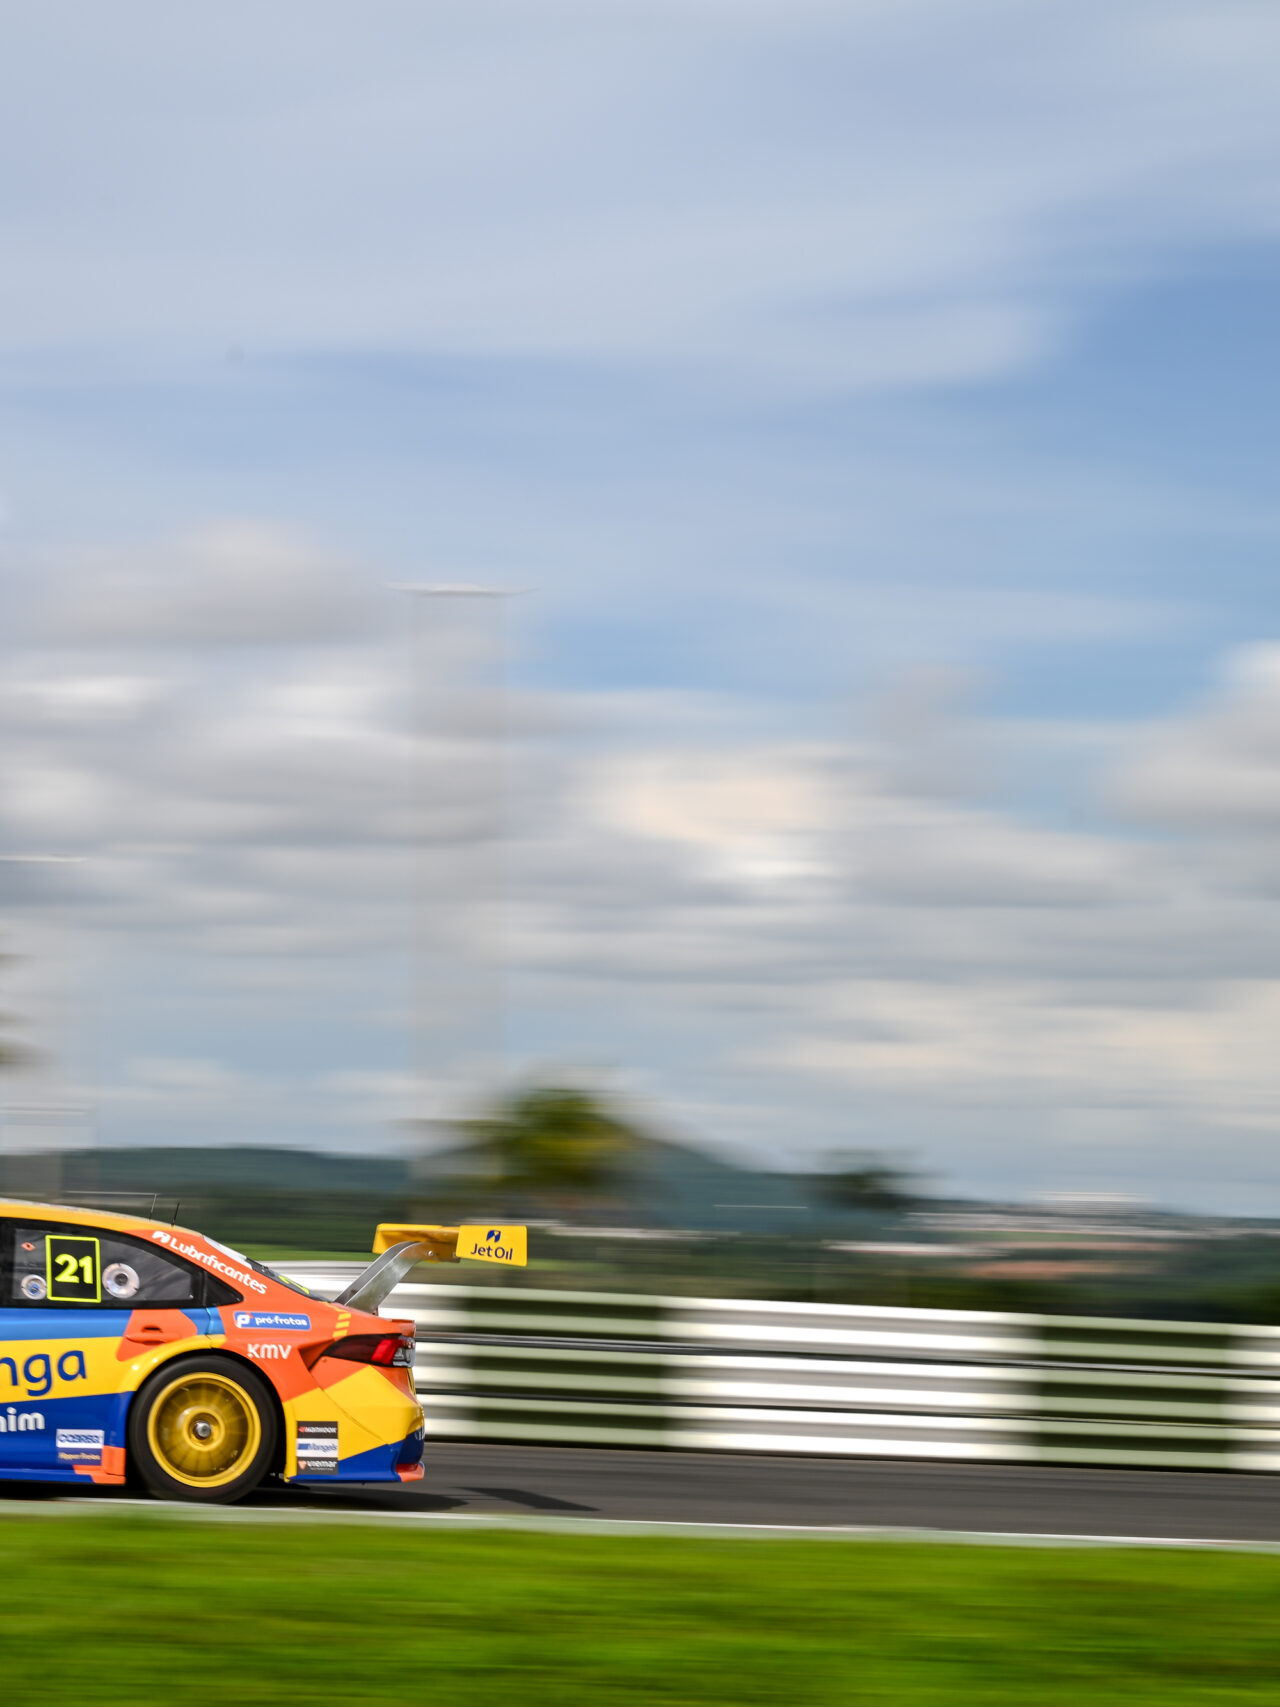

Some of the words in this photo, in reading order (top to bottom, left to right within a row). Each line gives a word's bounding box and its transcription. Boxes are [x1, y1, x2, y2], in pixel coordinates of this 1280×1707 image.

[470, 1243, 492, 1258] Jet
[494, 1246, 513, 1260] Oil
[54, 1253, 94, 1284] 21
[170, 1236, 267, 1295] Lubrificantes
[254, 1315, 308, 1326] pro-frotas
[247, 1343, 292, 1360] KMV
